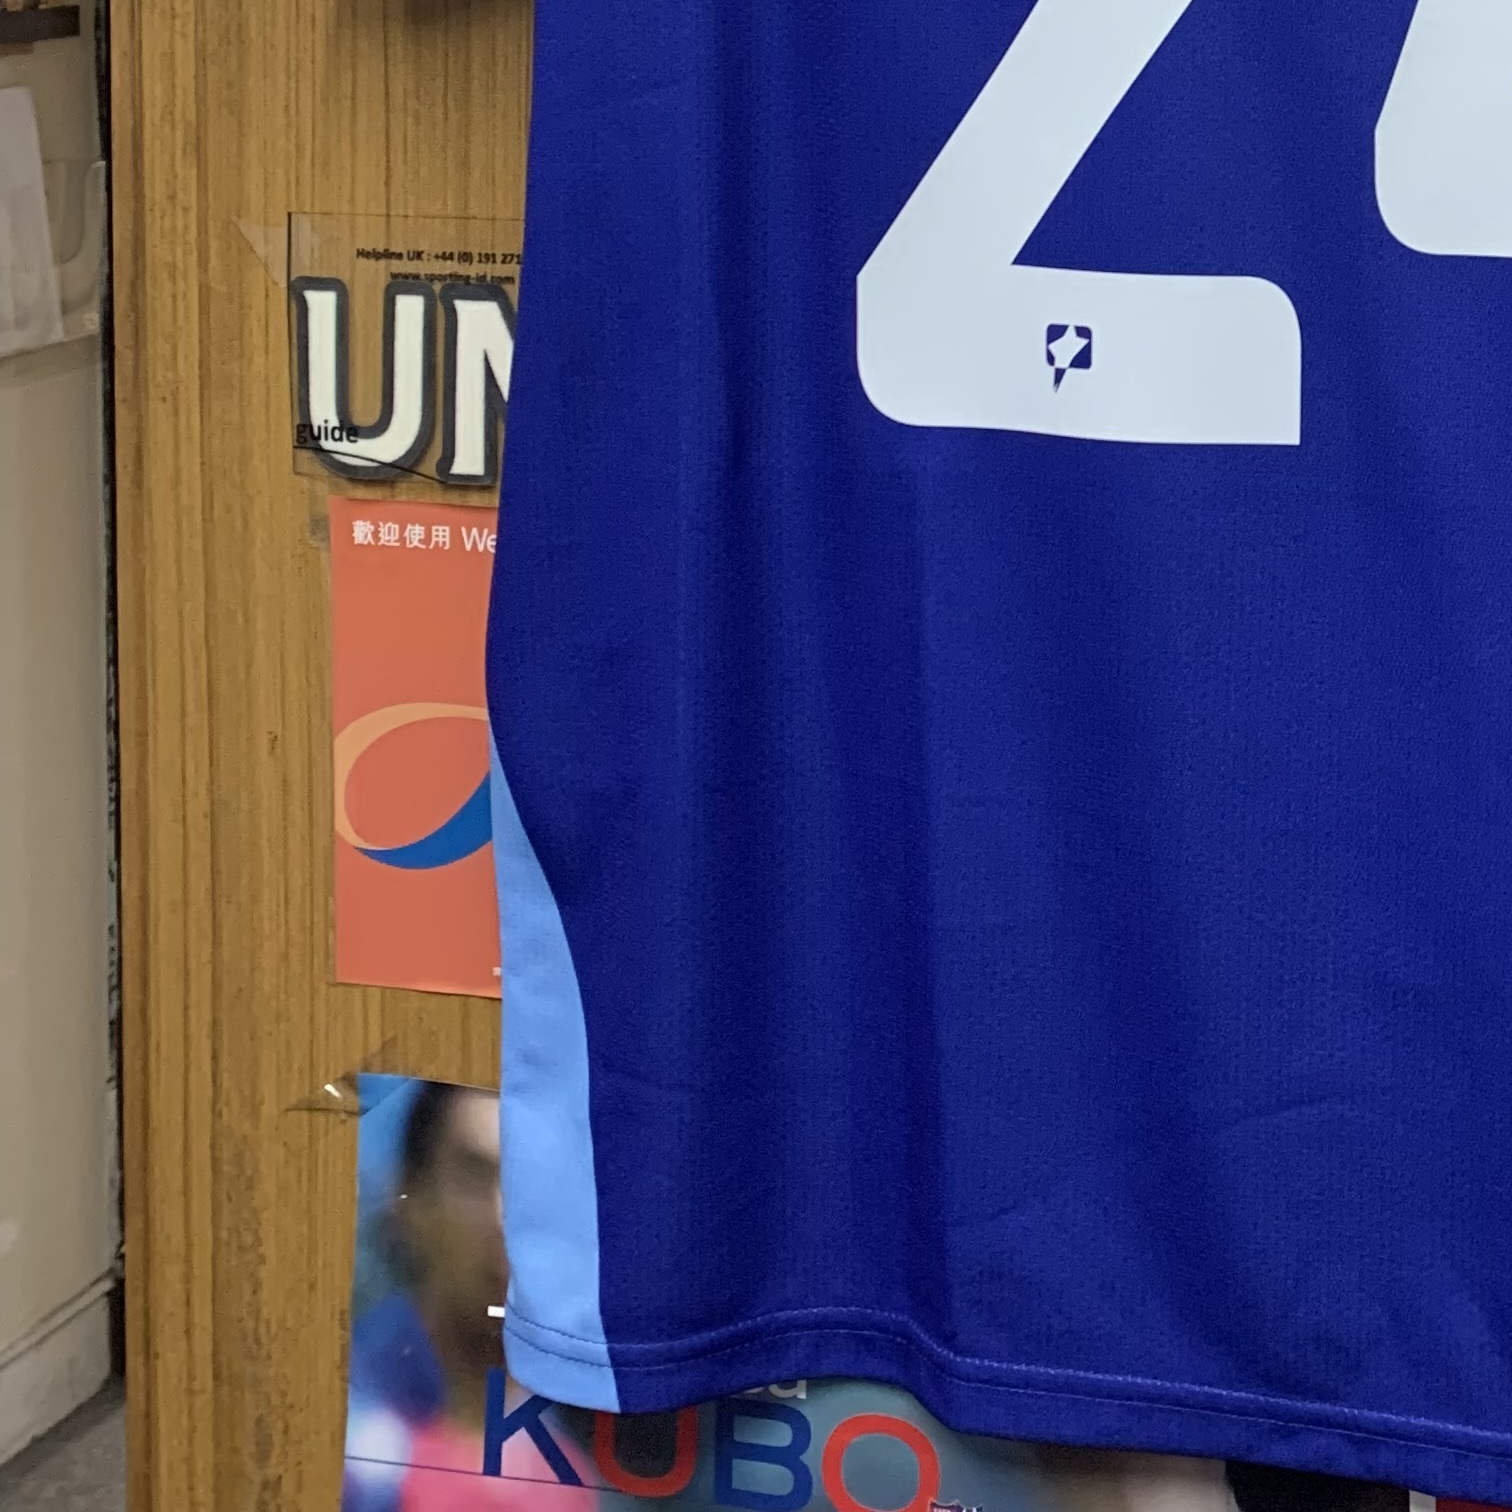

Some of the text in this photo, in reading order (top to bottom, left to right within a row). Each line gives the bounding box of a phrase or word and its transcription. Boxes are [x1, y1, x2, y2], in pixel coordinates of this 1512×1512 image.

[356, 248, 404, 262] Helpline
[406, 250, 425, 262] UK
[433, 252, 454, 262] +44
[457, 252, 474, 266] (0)
[476, 252, 498, 264] 191
[295, 419, 360, 445] guide
[352, 520, 451, 551] 歡迎使用
[482, 1366, 941, 1512] KUBO
